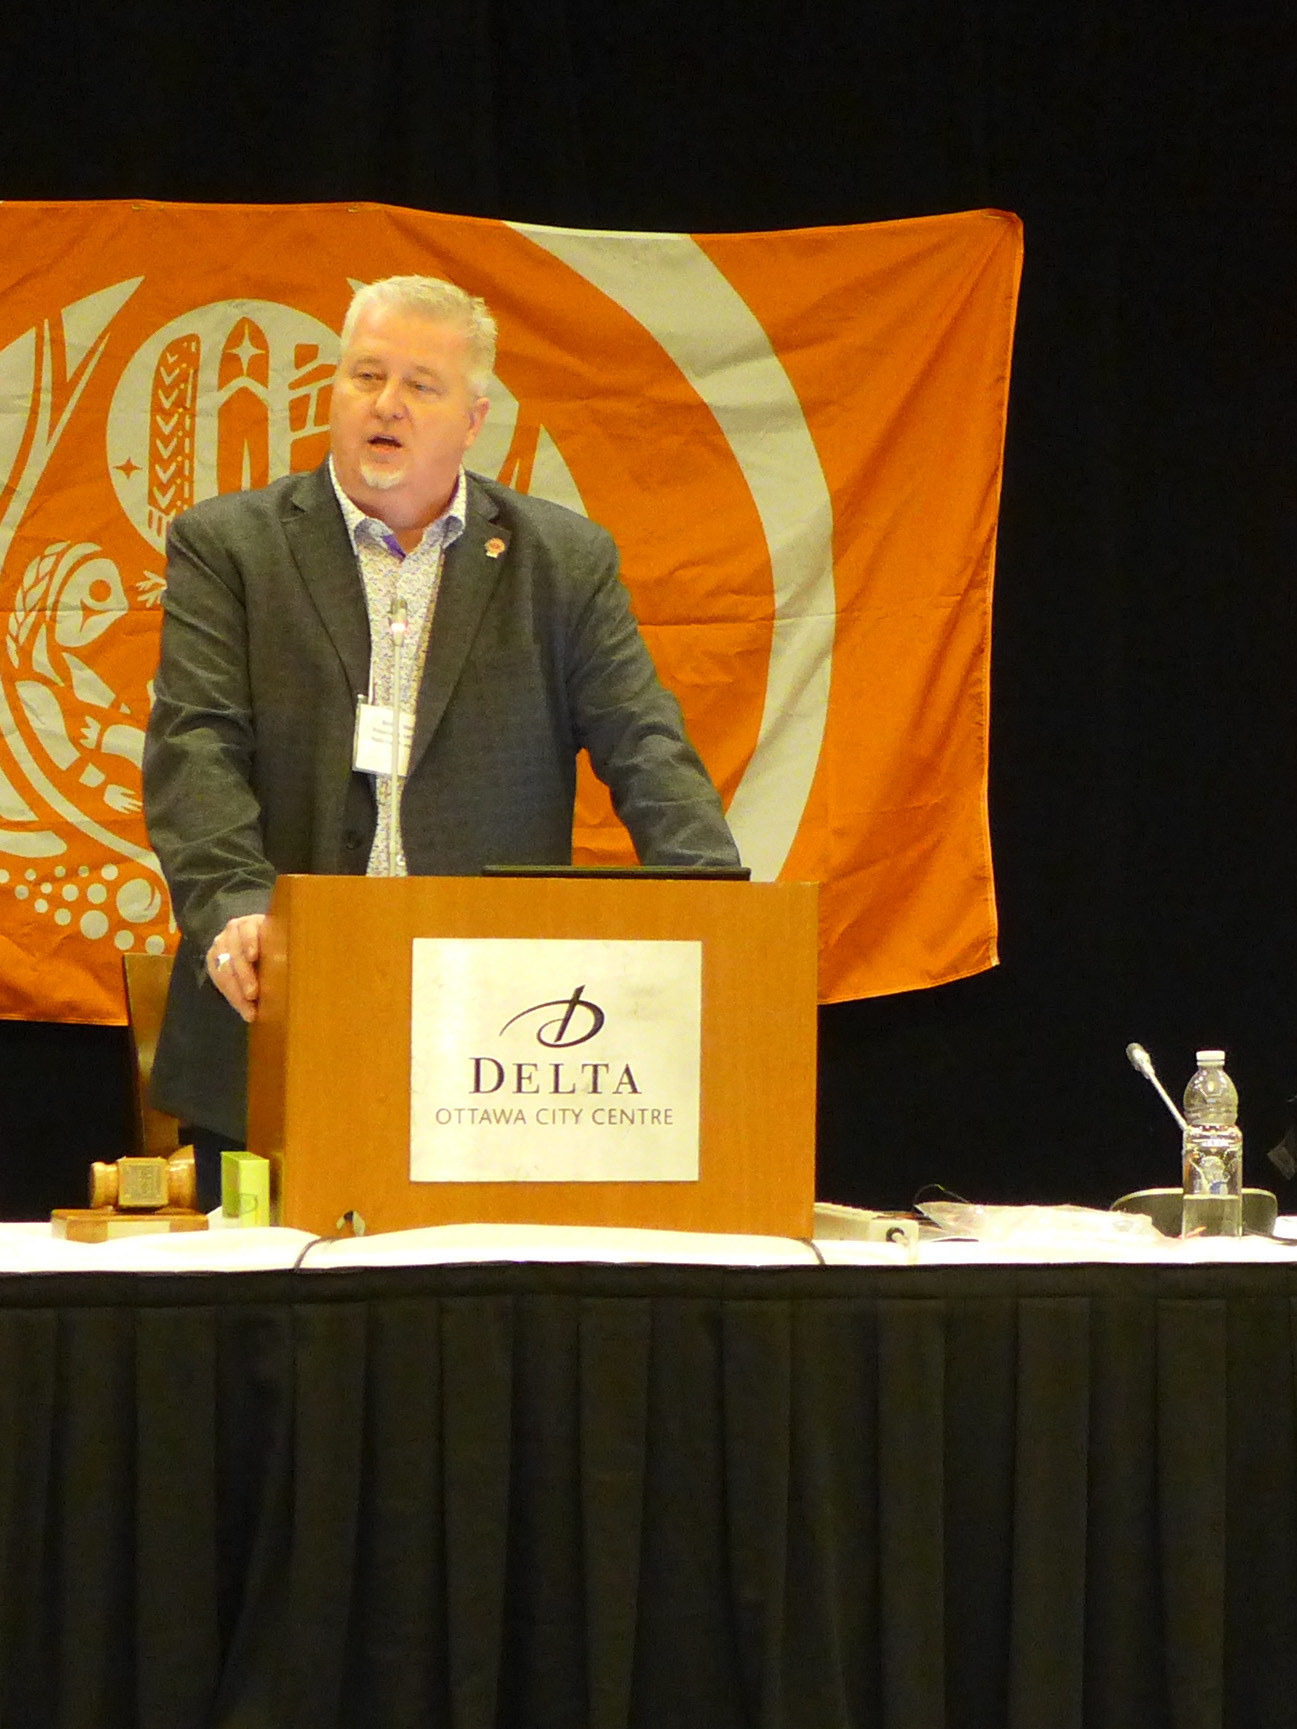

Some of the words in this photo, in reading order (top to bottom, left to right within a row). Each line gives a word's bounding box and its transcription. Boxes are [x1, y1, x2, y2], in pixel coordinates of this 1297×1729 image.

[468, 1057, 642, 1094] DELTA
[435, 1108, 527, 1125] OTTAWA
[535, 1108, 583, 1125] CITY
[591, 1108, 674, 1125] CENTRE
